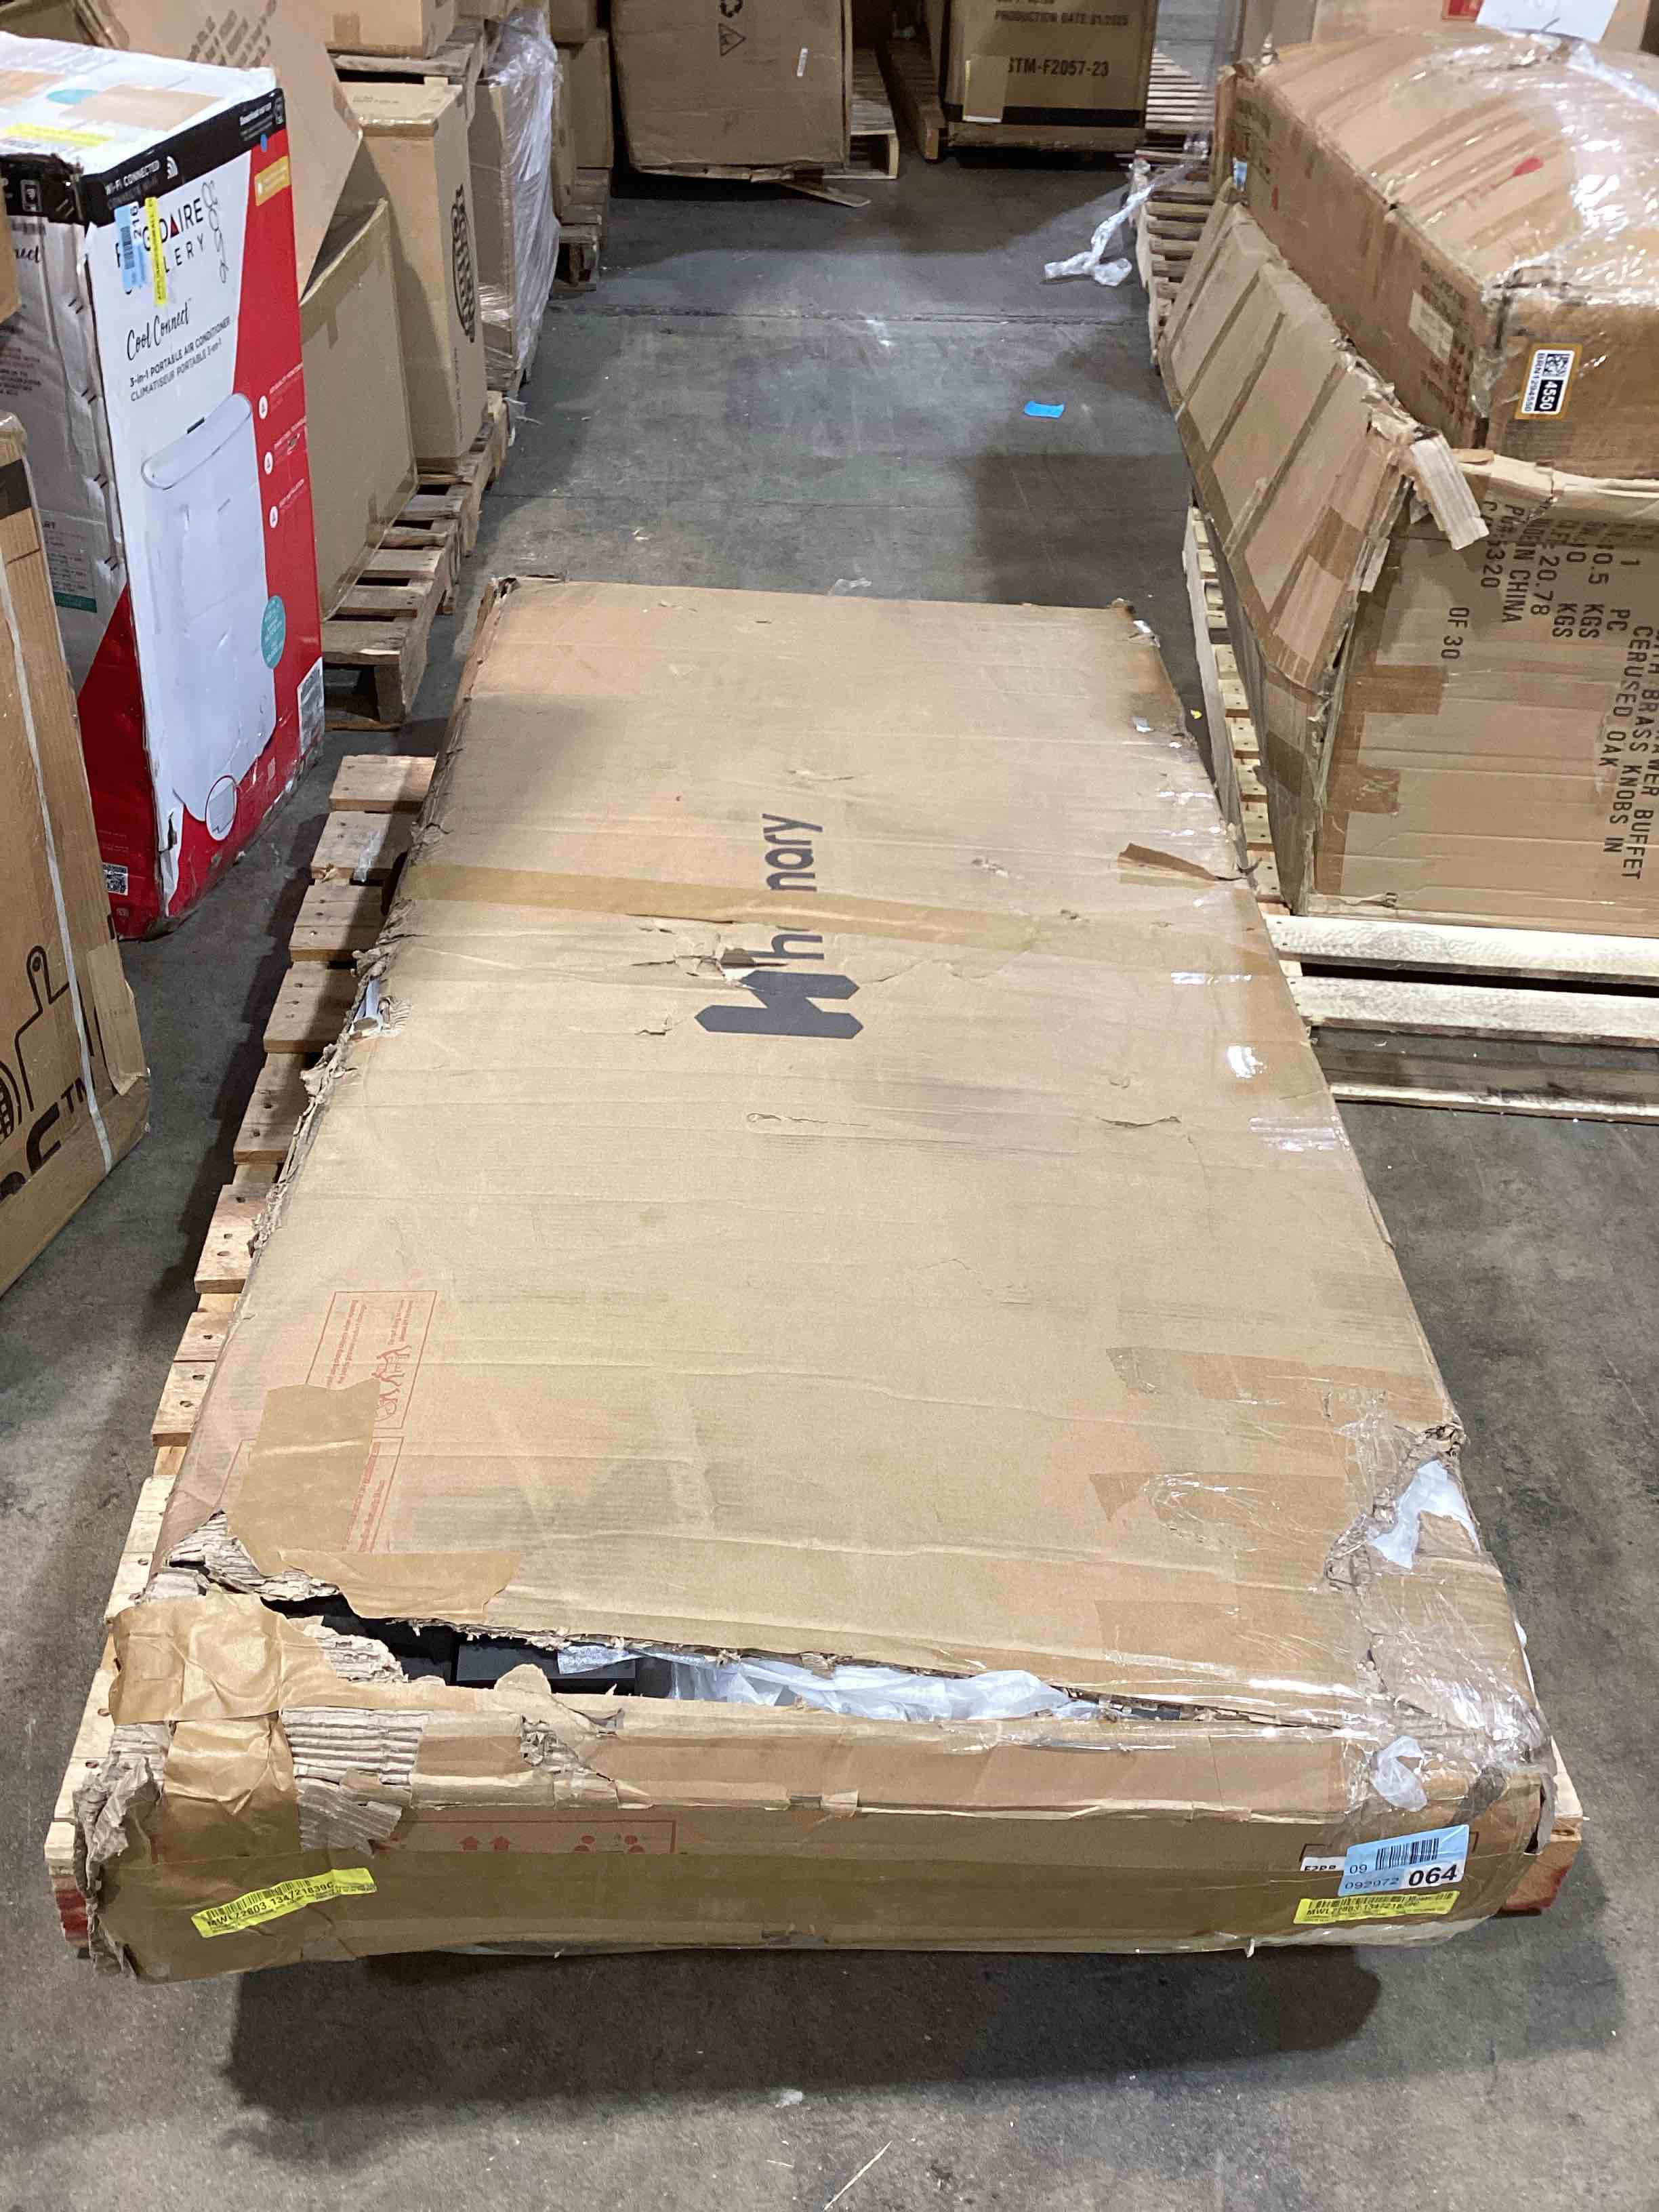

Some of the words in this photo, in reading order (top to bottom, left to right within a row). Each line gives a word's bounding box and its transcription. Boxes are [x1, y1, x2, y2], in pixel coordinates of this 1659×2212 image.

[127, 322, 151, 361] Cool
[154, 302, 188, 346] Connect
[150, 349, 183, 376] PORTABLE
[184, 342, 194, 356] AIR
[195, 315, 230, 348] CONDITIONER
[1539, 381, 1558, 410] 4550
[1502, 570, 1531, 623] CHINA
[1448, 607, 1470, 628] OF
[1552, 603, 1578, 638] KGS
[1578, 604, 1605, 638] KGS
[1607, 609, 1631, 632] PC
[1441, 635, 1463, 660] 30
[1613, 626, 1654, 717] CERUSED
[1629, 689, 1659, 752] BRASS
[1598, 731, 1626, 766] OAK
[1609, 765, 1643, 825] KNOBS
[1603, 837, 1625, 853] IN
[1621, 809, 1654, 880] BUFFET
[1345, 1878, 1400, 1890] 092072
[1349, 1864, 1368, 1875] 09
[1408, 1864, 1457, 1886] 064
